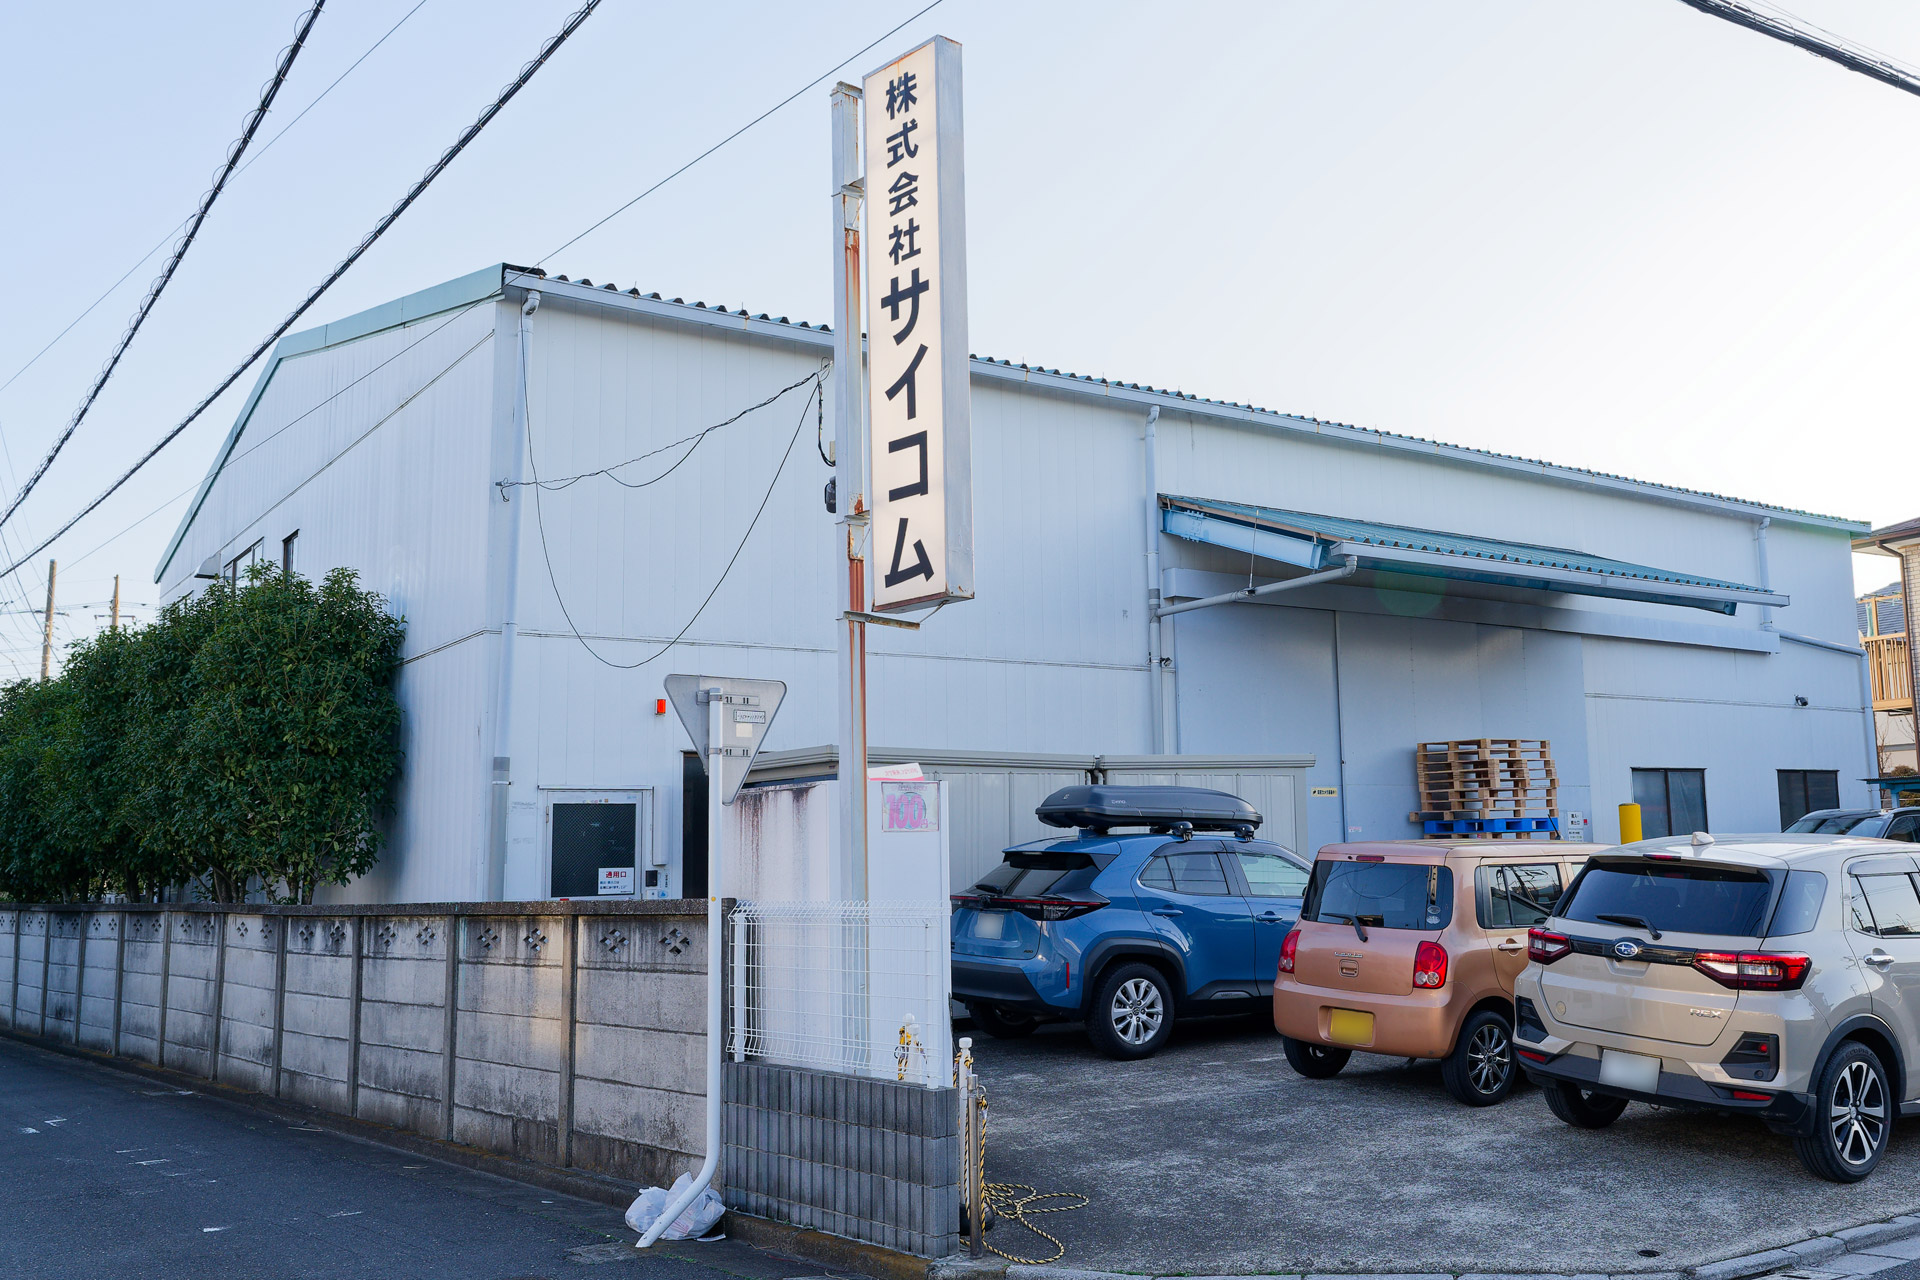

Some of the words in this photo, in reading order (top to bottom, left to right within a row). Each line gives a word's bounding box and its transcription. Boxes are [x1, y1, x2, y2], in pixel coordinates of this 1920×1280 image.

[881, 71, 934, 588] 株式会社サイコム
[605, 871, 627, 879] 通用口
[1689, 1008, 1721, 1019] REX
